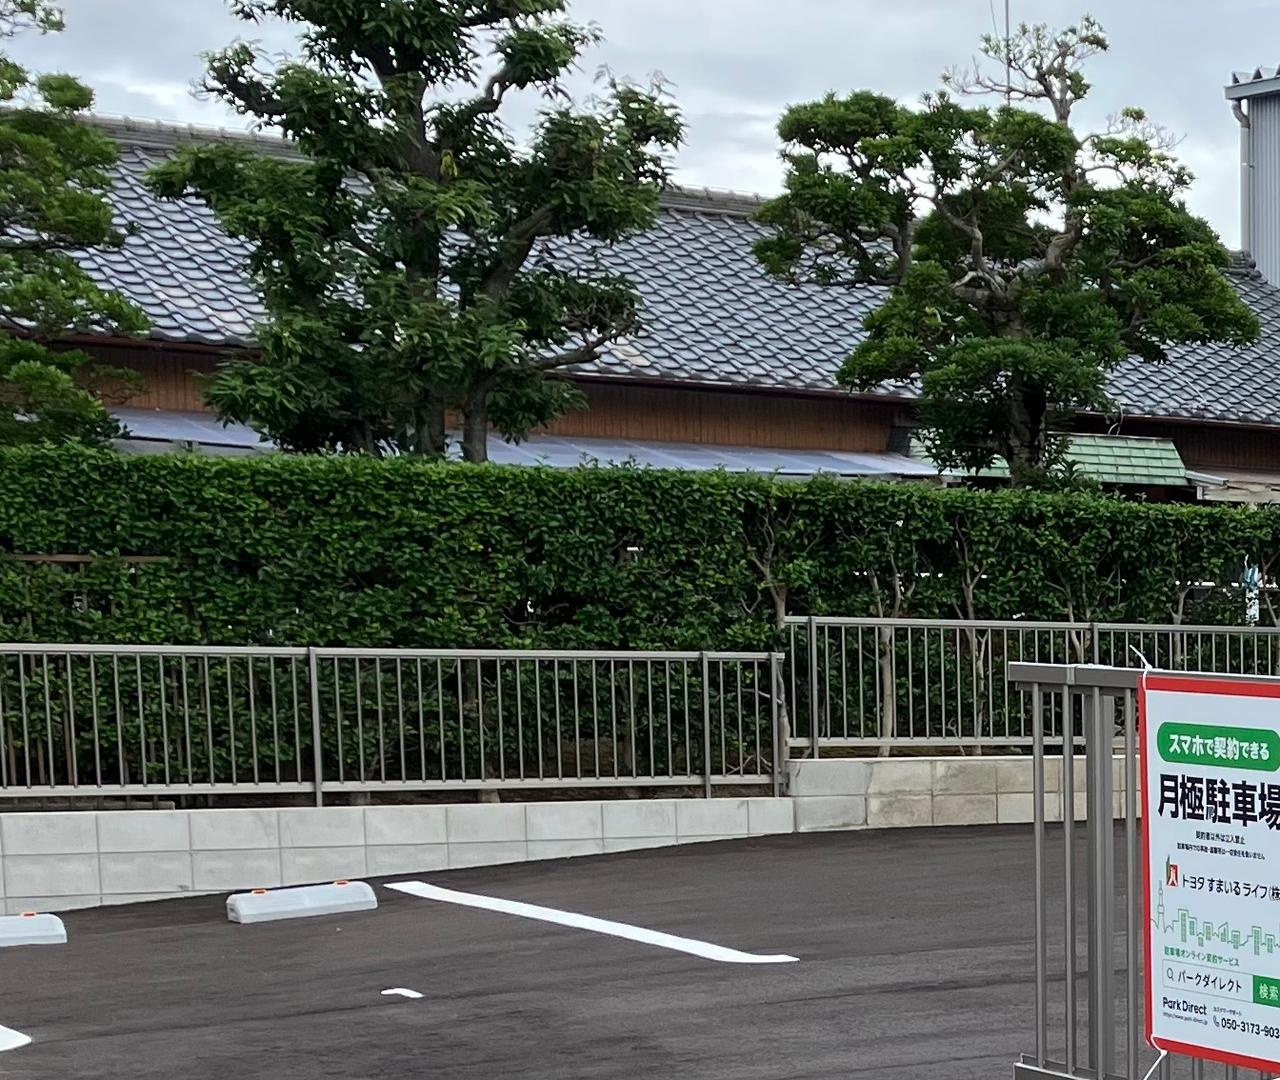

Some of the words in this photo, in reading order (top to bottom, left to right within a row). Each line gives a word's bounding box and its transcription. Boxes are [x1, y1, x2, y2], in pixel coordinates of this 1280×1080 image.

[1169, 734, 1270, 761] スマホで契約できる
[1162, 997, 1181, 1012] Park
[1182, 1000, 1207, 1015] Direct
